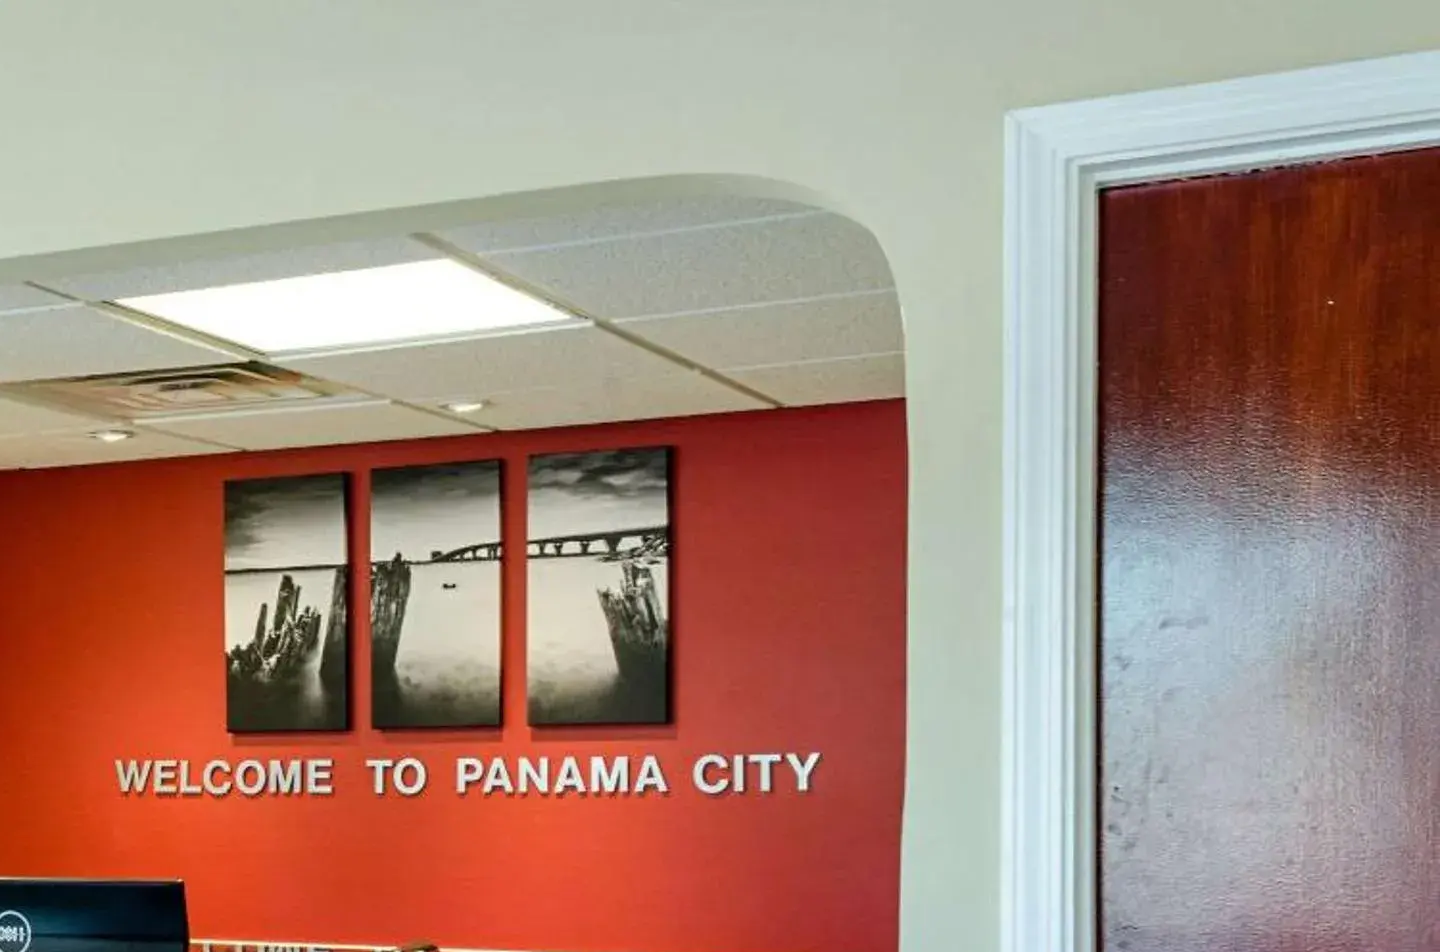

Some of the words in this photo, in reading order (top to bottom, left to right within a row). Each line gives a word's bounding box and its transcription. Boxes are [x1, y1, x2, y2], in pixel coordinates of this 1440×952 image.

[114, 758, 334, 795] WELCOME
[366, 757, 427, 796] TO
[455, 754, 668, 794] PANAMA
[692, 751, 822, 794] CITY
